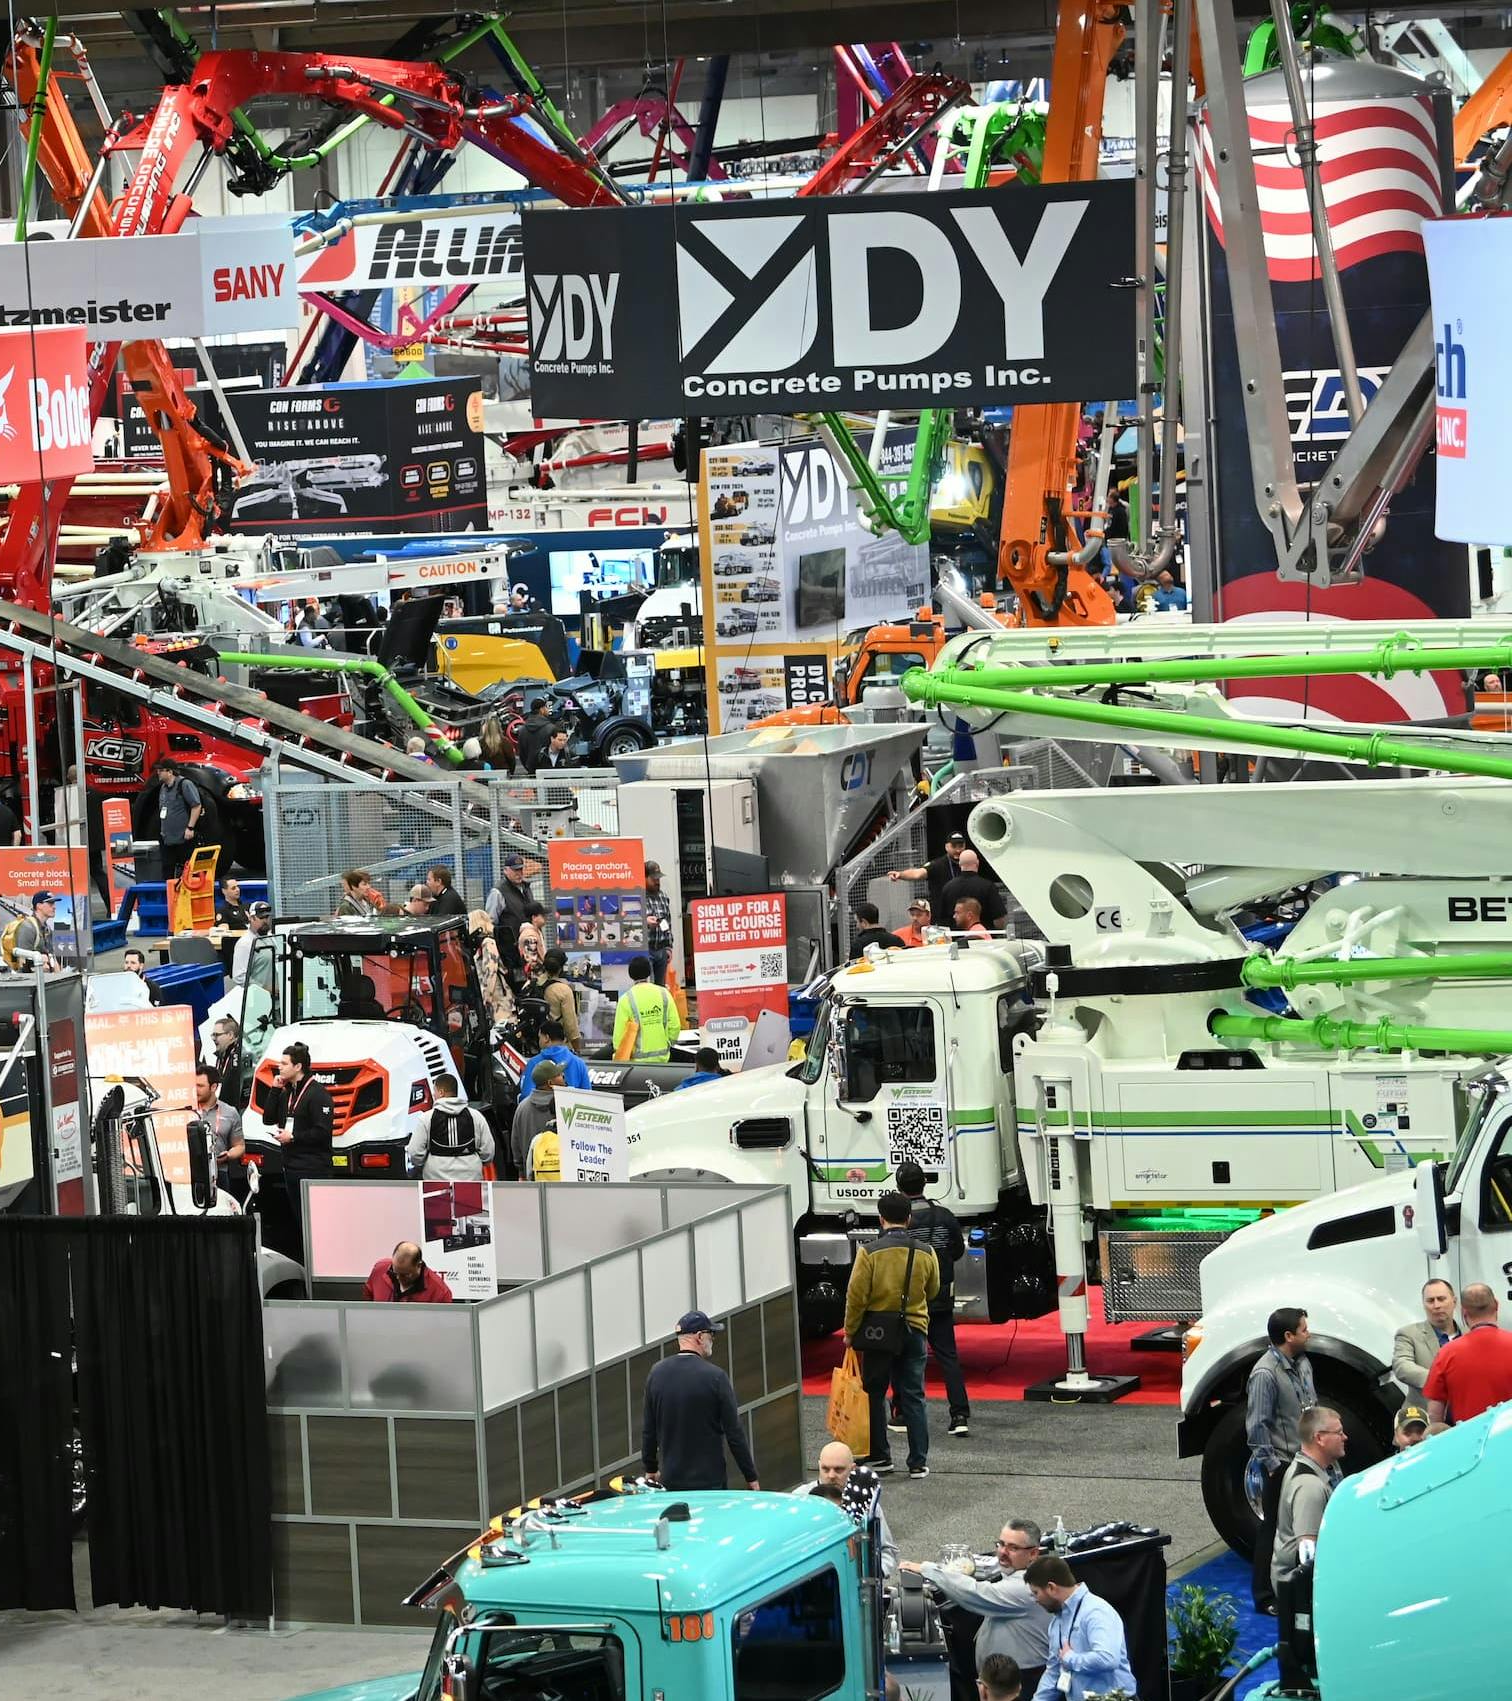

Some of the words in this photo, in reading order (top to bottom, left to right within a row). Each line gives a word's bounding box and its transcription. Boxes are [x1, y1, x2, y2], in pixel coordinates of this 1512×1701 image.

[117, 163, 150, 237] CONCRET
[368, 221, 524, 280] ALLIA
[213, 263, 285, 302] SANY
[534, 361, 569, 374] Concrete
[571, 362, 597, 376] Pumps
[598, 362, 614, 374] Inc.
[684, 372, 841, 398] Concrete
[854, 366, 972, 395] Pumps
[985, 364, 1052, 388] Inc.
[29, 375, 91, 452] Bobc
[270, 401, 289, 413] CON
[291, 400, 323, 412] FORMS
[268, 420, 297, 431] RISE
[307, 419, 344, 430] ABOVE
[1293, 451, 1339, 462] CRET
[785, 527, 818, 543] Concrete
[419, 562, 476, 578] CAUTION
[88, 741, 140, 760] KCP
[840, 749, 876, 791] CDT
[8, 870, 44, 878] Concrete
[563, 863, 592, 873] Placing
[594, 862, 631, 870] anchors.
[17, 878, 39, 887] Small
[42, 878, 64, 887] studs.
[570, 872, 595, 881] steps.
[597, 871, 634, 880] Yourself.
[697, 903, 725, 918] SIGN
[728, 903, 743, 917] UP
[747, 901, 769, 914] FOR
[773, 900, 781, 912] A
[698, 918, 729, 933] FREE
[733, 914, 782, 930] COURSE
[700, 935, 717, 944] AND
[720, 932, 747, 942] ENTER
[749, 930, 760, 940] TO
[762, 929, 782, 939] WIN!
[716, 1037, 740, 1049] iPad
[560, 1104, 613, 1131] WESTERN
[571, 1139, 596, 1151] Follow
[598, 1143, 613, 1154] The
[579, 1153, 606, 1165] Leader
[837, 1189, 874, 1198] USDOT
[865, 1324, 884, 1340] GO
[666, 1613, 713, 1643] 181
